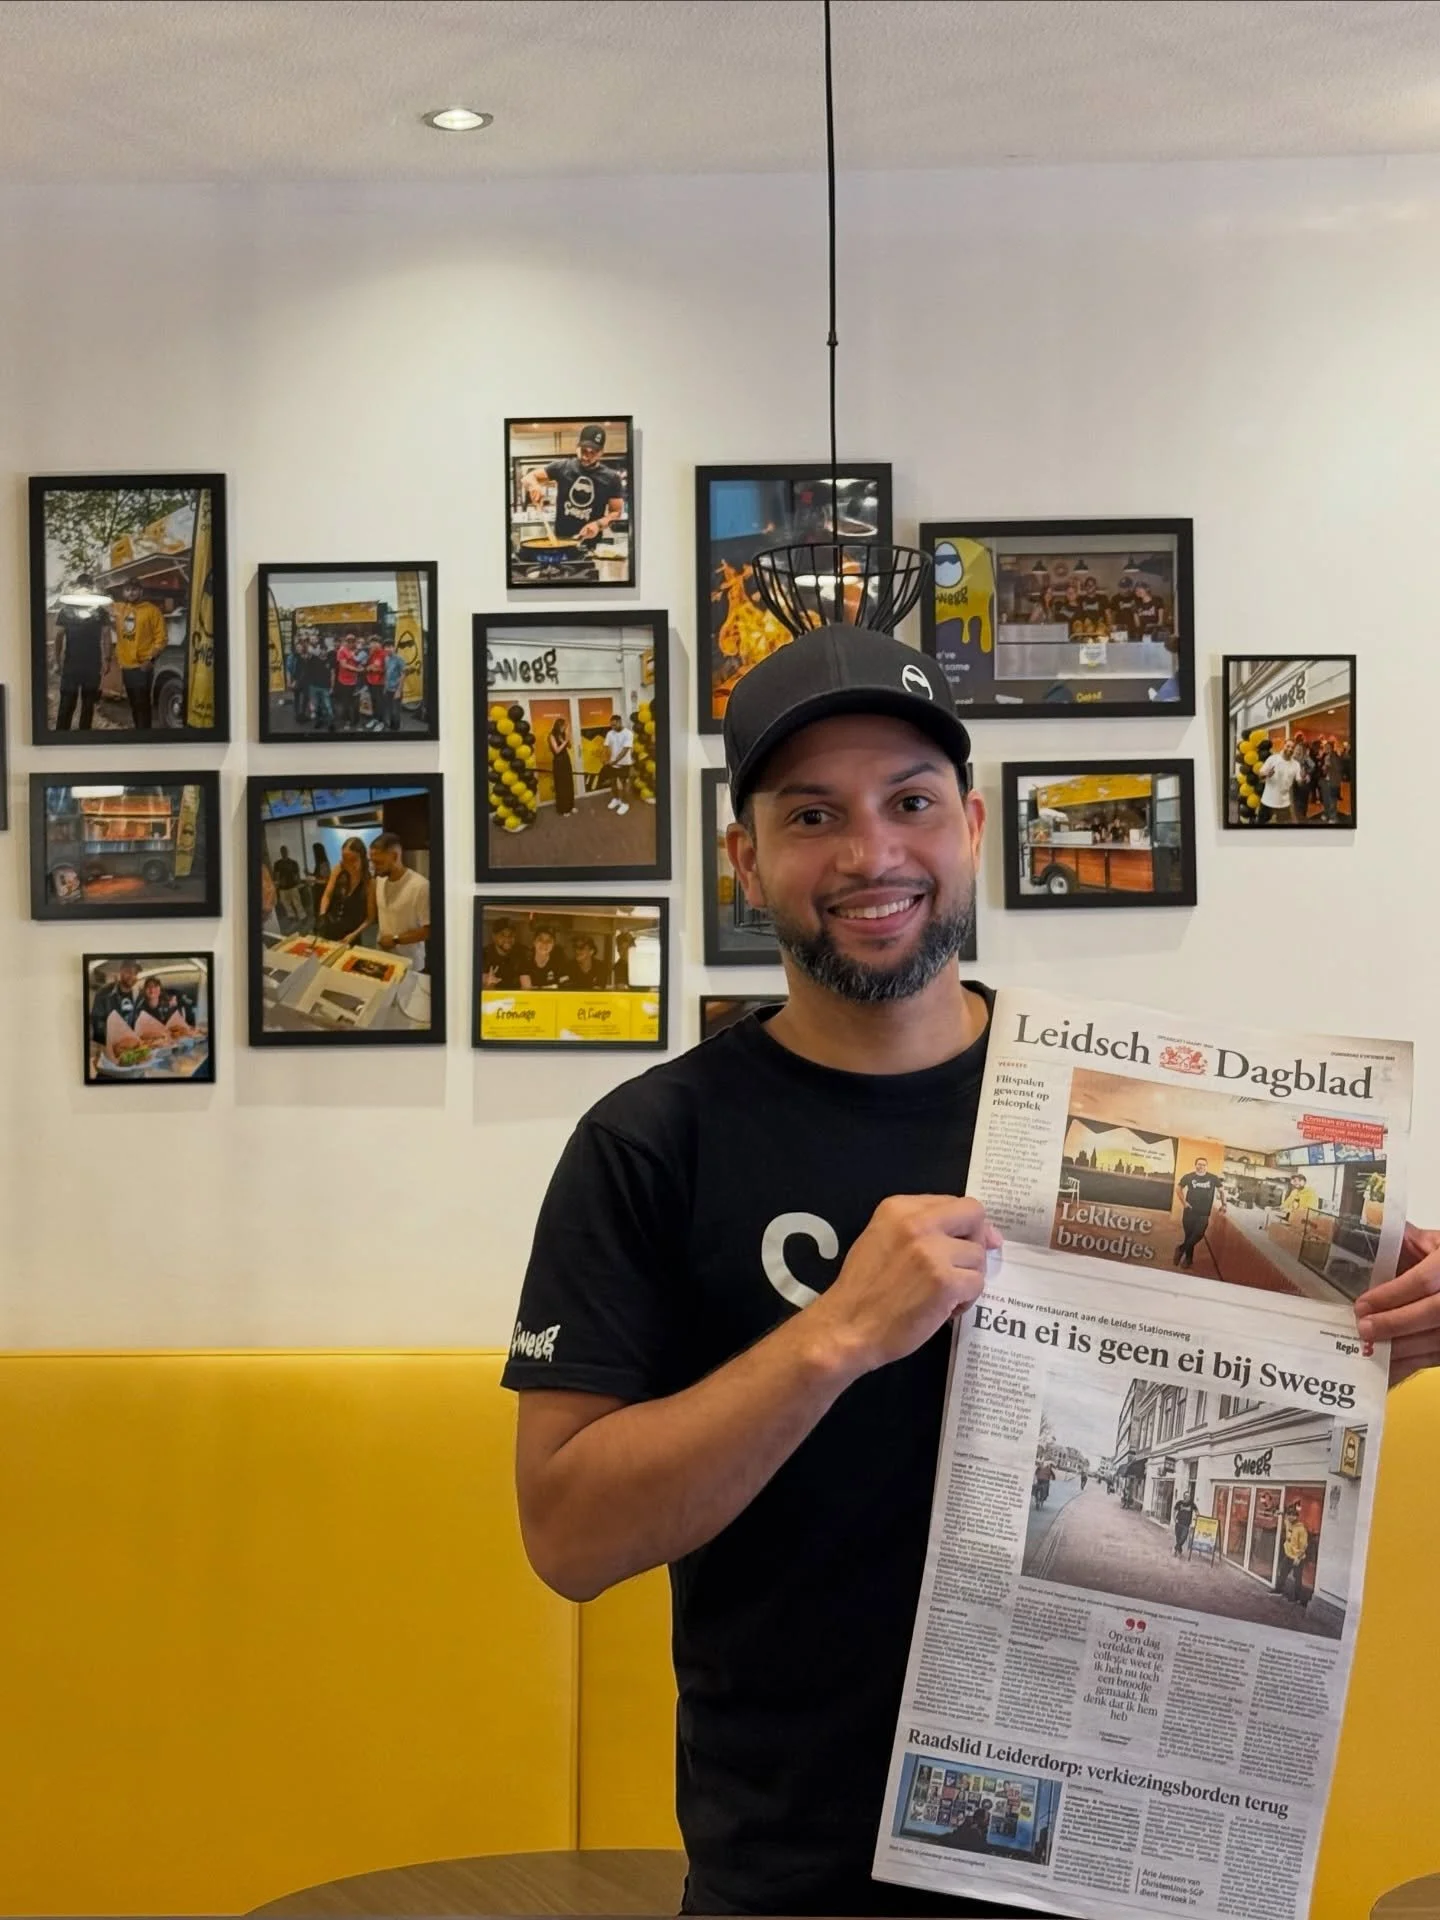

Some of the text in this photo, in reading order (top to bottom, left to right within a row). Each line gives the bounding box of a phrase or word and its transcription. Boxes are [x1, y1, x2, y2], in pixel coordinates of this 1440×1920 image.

[1013, 1014, 1373, 1099] Leidsch Dagblad
[992, 1098, 1041, 1111] risicoplek
[993, 1088, 1050, 1102] gewenst op
[1061, 1201, 1152, 1234] Lekkere
[1057, 1225, 1154, 1259] broodjes
[1008, 1297, 1034, 1309] Nieuw
[1035, 1303, 1079, 1319] restaurant
[1081, 1312, 1096, 1322] aan
[1098, 1314, 1109, 1325] de
[1111, 1317, 1137, 1331] Leidse
[1138, 1323, 1191, 1342] Stationsweg
[972, 1304, 1356, 1409] Eén ei is geen ei bij Swegg
[1336, 1339, 1374, 1357] Regio 3
[1234, 1447, 1273, 1477] Swegg
[1098, 1641, 1134, 1655] vertelde
[1136, 1647, 1145, 1658] ik
[1108, 1630, 1122, 1643] Op
[1143, 1636, 1160, 1650] dag
[1105, 1662, 1123, 1675] heb
[1125, 1668, 1137, 1677] nu
[1139, 1671, 1159, 1682] toch
[1130, 1659, 1151, 1669] weet
[1117, 1676, 1152, 1693] broodje
[1083, 1693, 1157, 1716] denk dat ik hem
[1110, 1709, 1128, 1721] heb
[908, 1728, 1289, 1820] Raadslid Leiderdorp: verkiezingsborden terug
[1188, 1896, 1197, 1905] in
